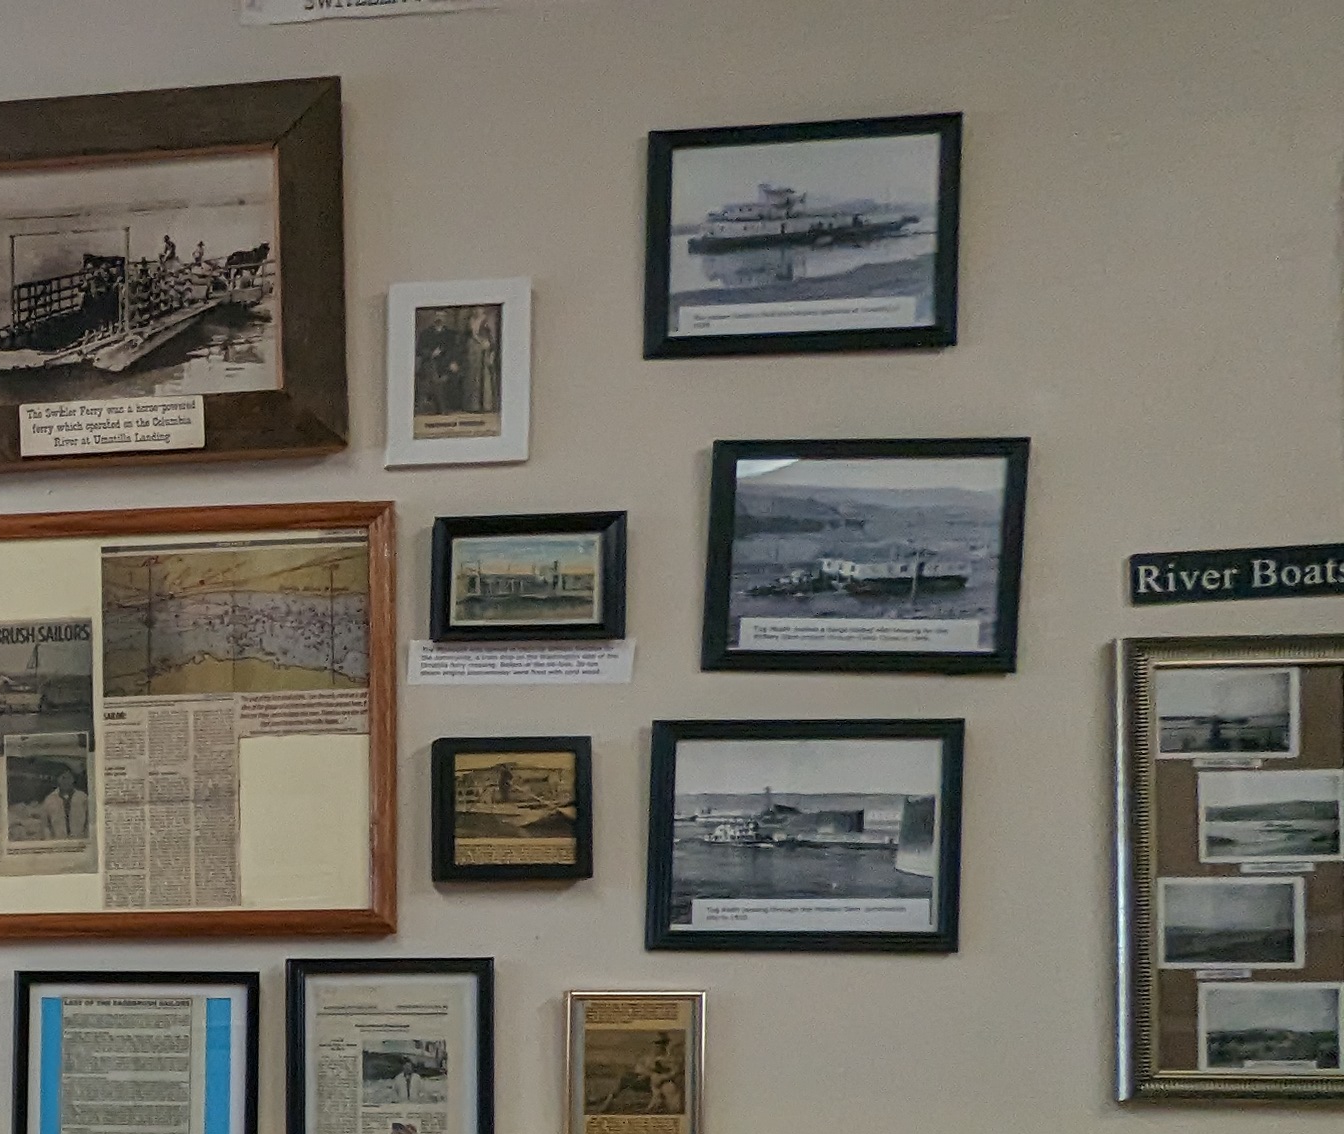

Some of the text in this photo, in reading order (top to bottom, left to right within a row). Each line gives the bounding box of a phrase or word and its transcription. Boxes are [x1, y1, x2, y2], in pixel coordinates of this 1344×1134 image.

[79, 405, 103, 418] Ferry
[57, 421, 84, 432] which
[135, 418, 151, 428] the
[53, 432, 172, 448] River at Umatilla Landing
[1136, 562, 1240, 594] River
[37, 623, 91, 643] SAILORS
